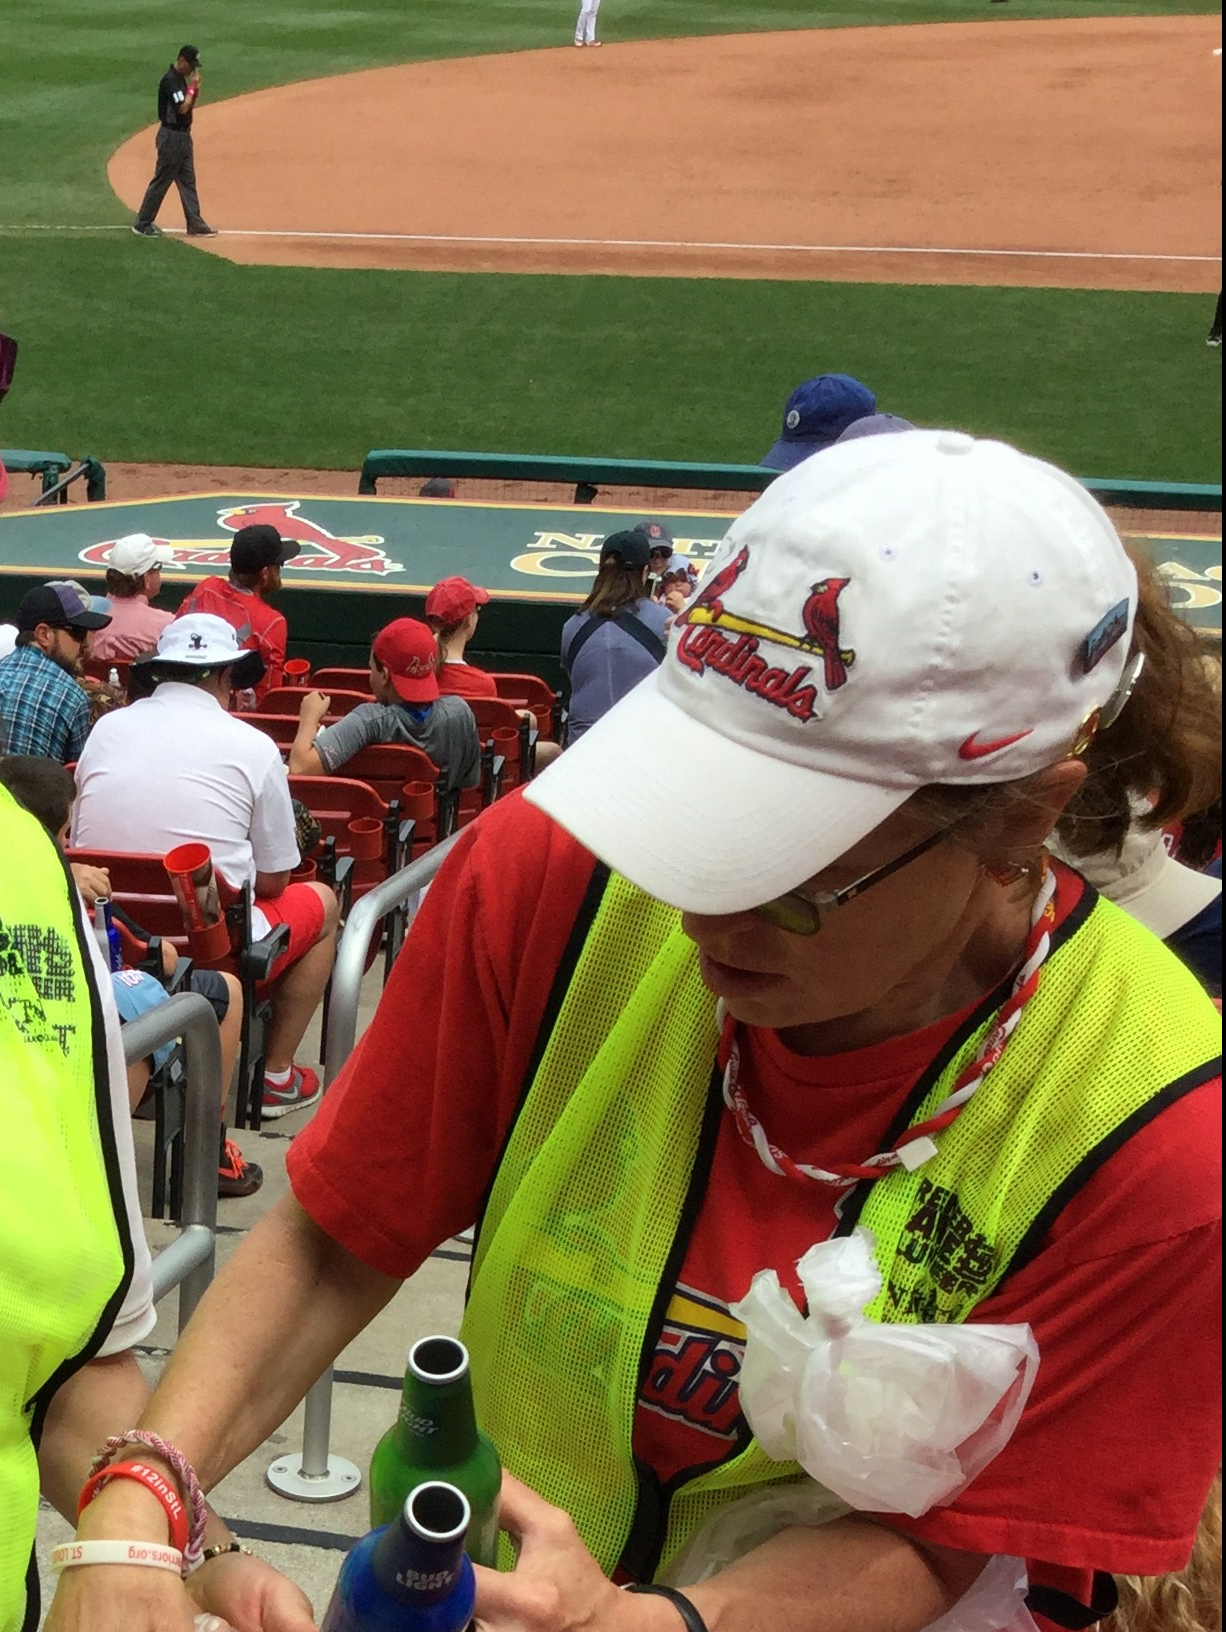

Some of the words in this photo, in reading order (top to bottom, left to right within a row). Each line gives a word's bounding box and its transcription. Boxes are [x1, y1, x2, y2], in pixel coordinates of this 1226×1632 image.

[677, 623, 818, 724] Cardinals
[394, 1570, 455, 1591] LIGHT
[405, 1568, 452, 1583] BUD
